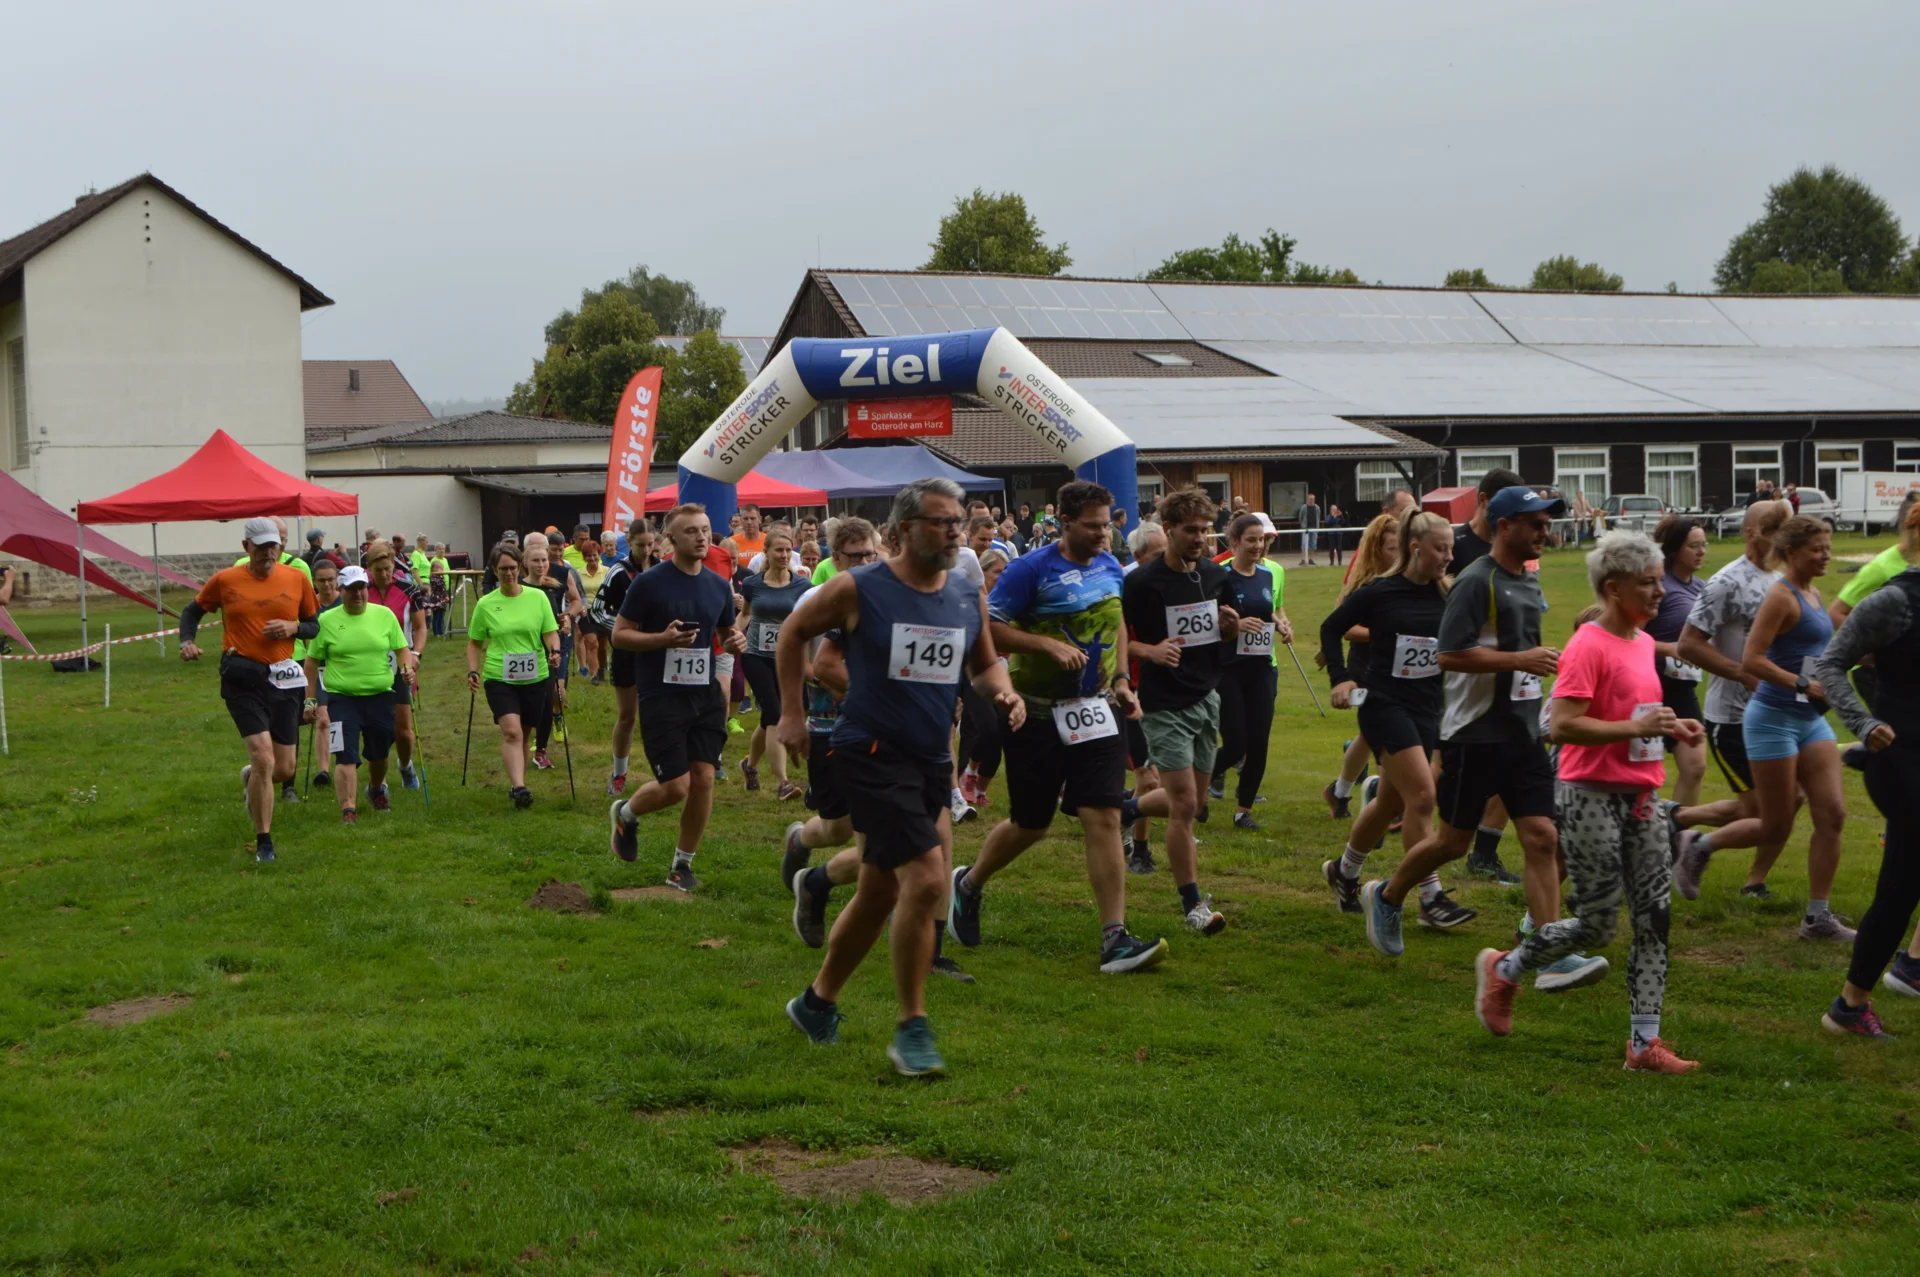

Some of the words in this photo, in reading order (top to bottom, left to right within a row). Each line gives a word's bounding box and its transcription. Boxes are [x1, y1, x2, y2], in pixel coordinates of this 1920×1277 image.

[839, 343, 942, 387] Ziel
[715, 386, 758, 432] OSTERODE
[1026, 373, 1076, 418] OSTERODE
[715, 379, 781, 449] INTERSPORT
[871, 411, 913, 422] Sparkasse
[994, 384, 1068, 454] STRICKER
[1008, 377, 1083, 443] INTERSPORT
[619, 385, 653, 493] Förste
[719, 395, 791, 465] STRICKER
[871, 421, 909, 431] Osterode
[909, 422, 923, 430] am
[923, 420, 944, 430] Harz
[1176, 612, 1214, 636] 263
[1244, 631, 1271, 646] 098
[508, 659, 535, 673] 215
[674, 657, 705, 675] 113
[905, 640, 954, 668] 149
[276, 665, 300, 681] 097
[1065, 705, 1106, 731] 065
